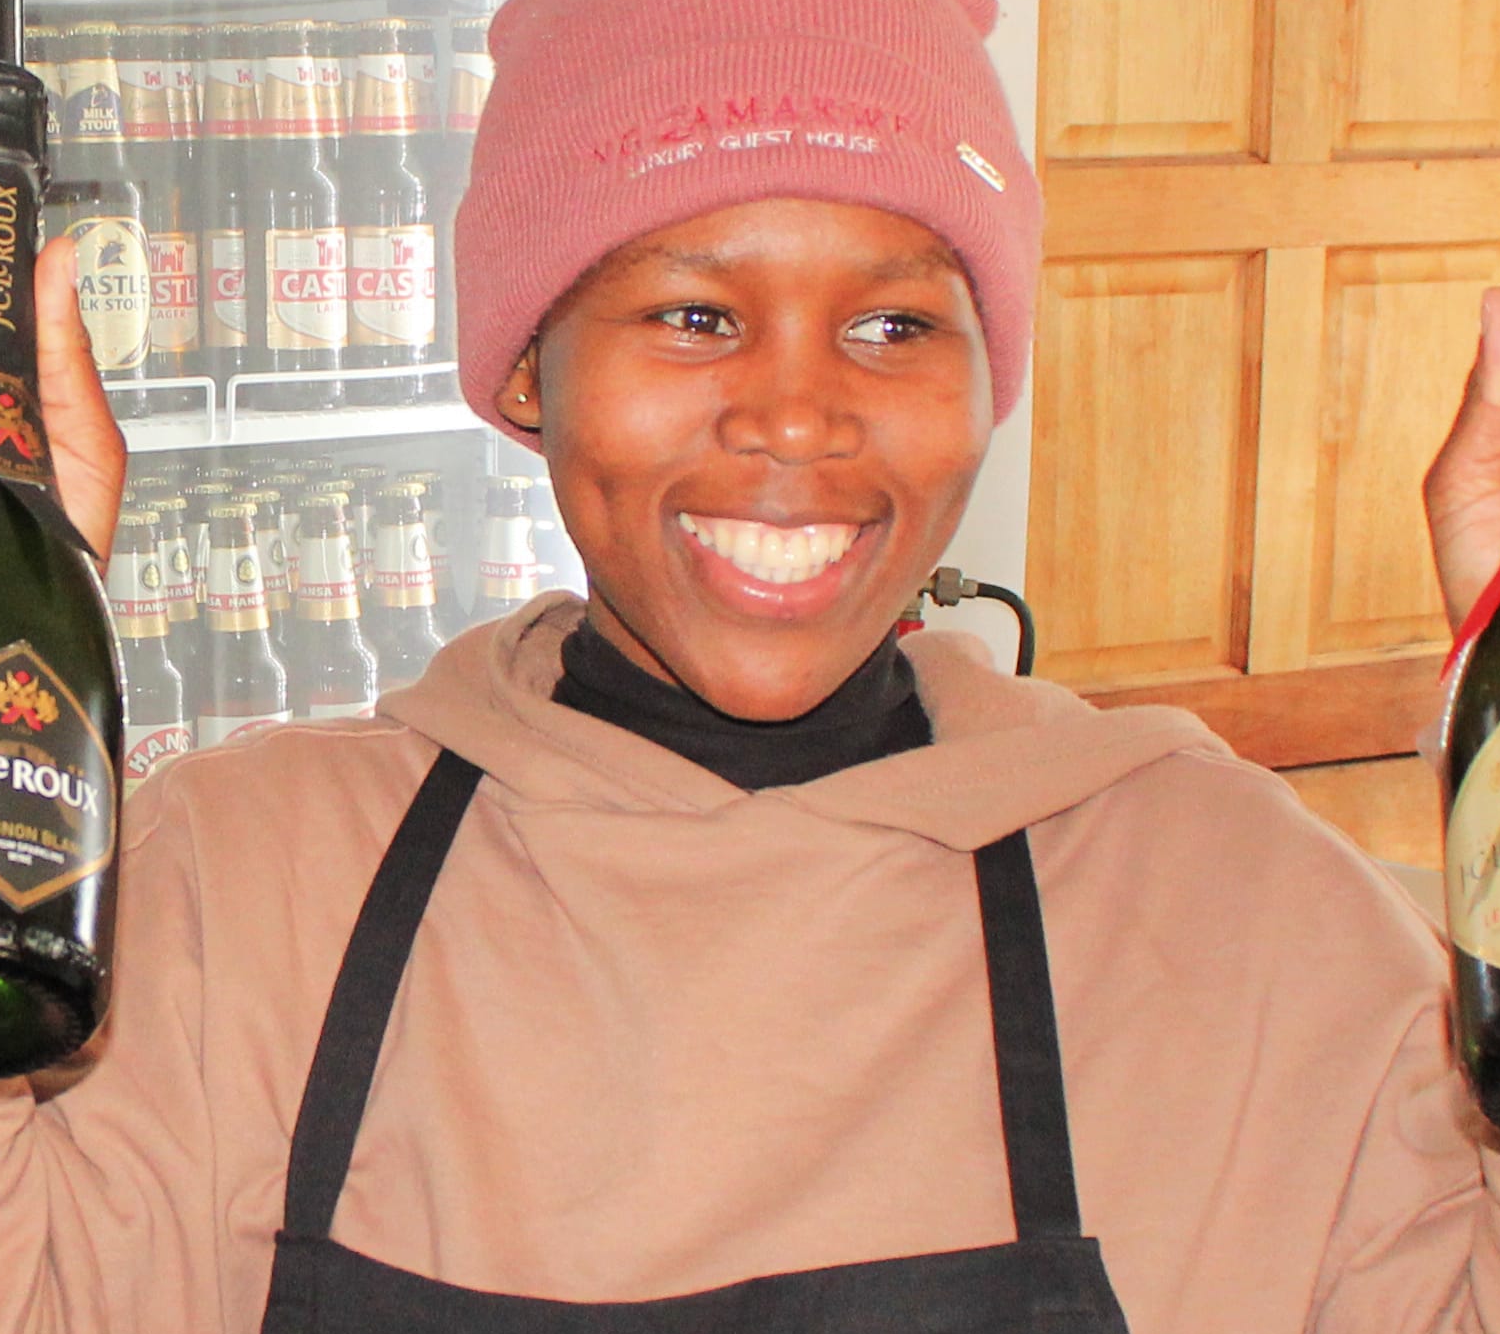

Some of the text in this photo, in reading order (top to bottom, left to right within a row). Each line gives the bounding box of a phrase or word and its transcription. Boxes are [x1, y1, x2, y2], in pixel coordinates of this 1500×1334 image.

[83, 107, 115, 120] MILK
[79, 119, 117, 132] STOUT
[79, 274, 147, 296] ASTLE
